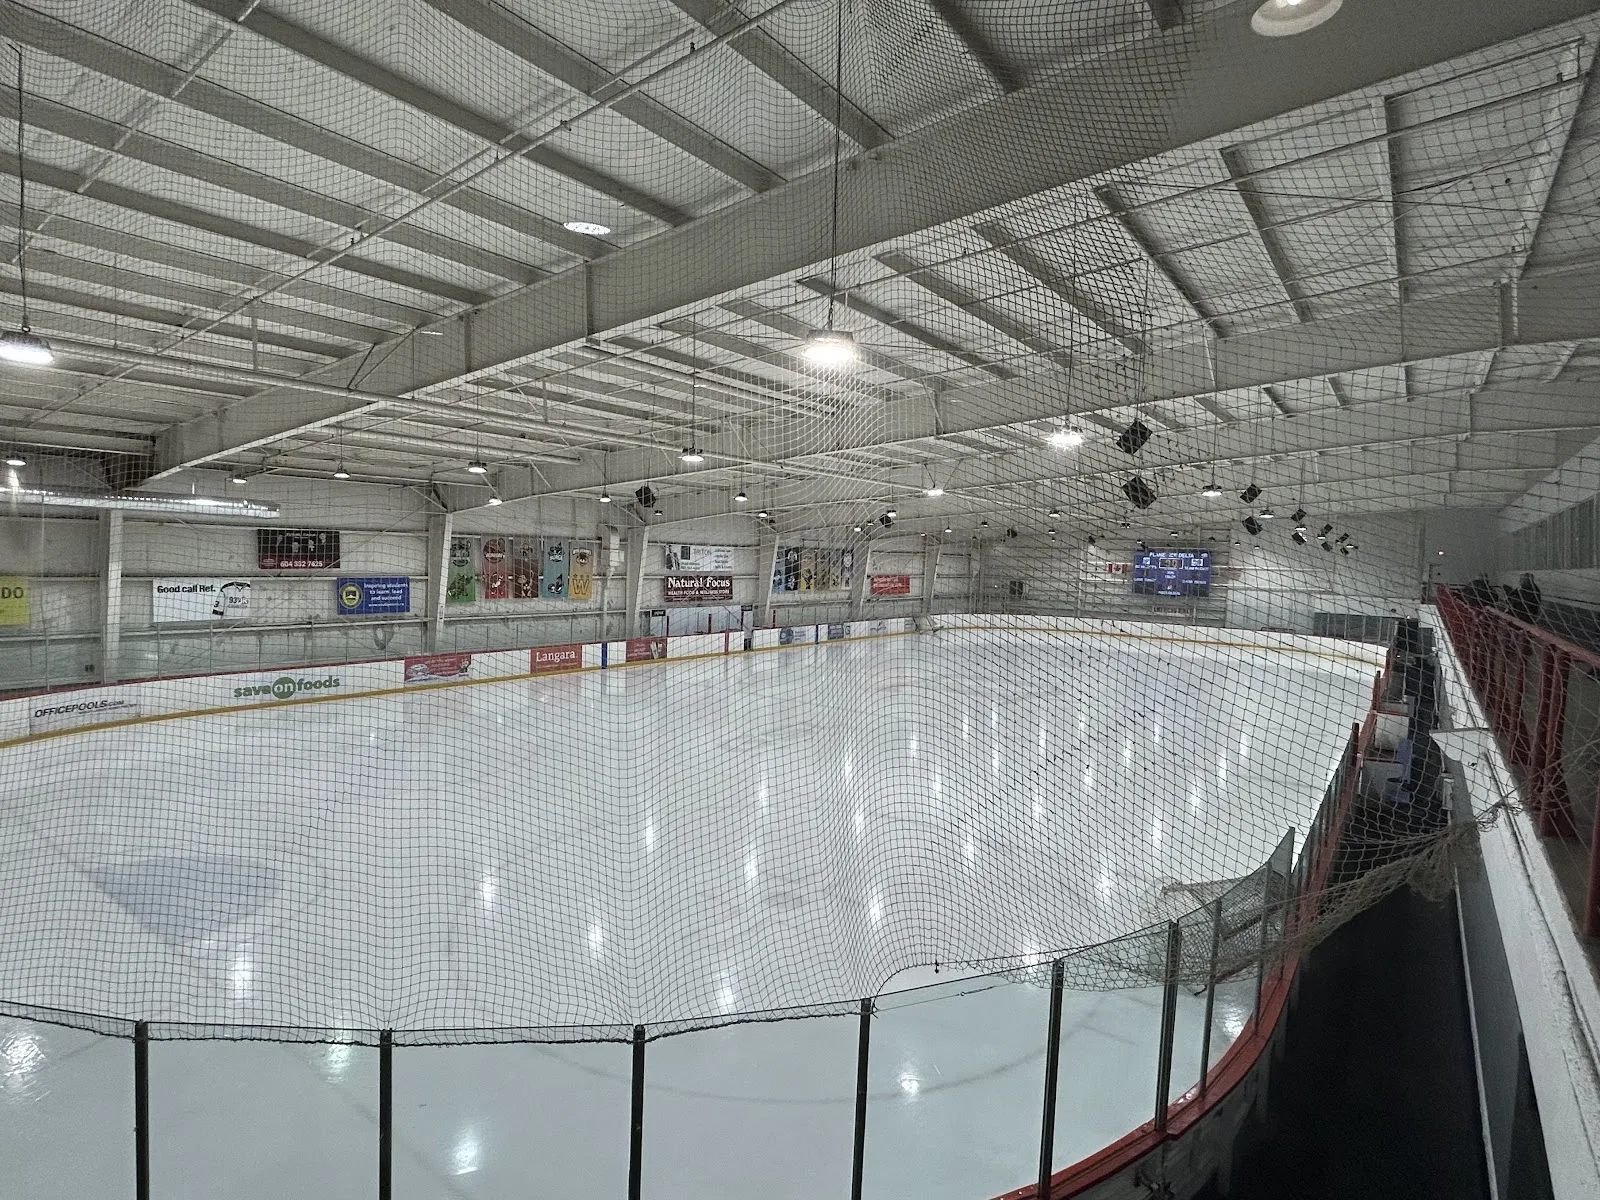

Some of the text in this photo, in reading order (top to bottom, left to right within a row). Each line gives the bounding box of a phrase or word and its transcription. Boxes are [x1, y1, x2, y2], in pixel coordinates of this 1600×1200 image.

[668, 577, 730, 588] Natural Focus
[157, 584, 216, 593] Good call Ref.
[536, 650, 576, 663] Langara
